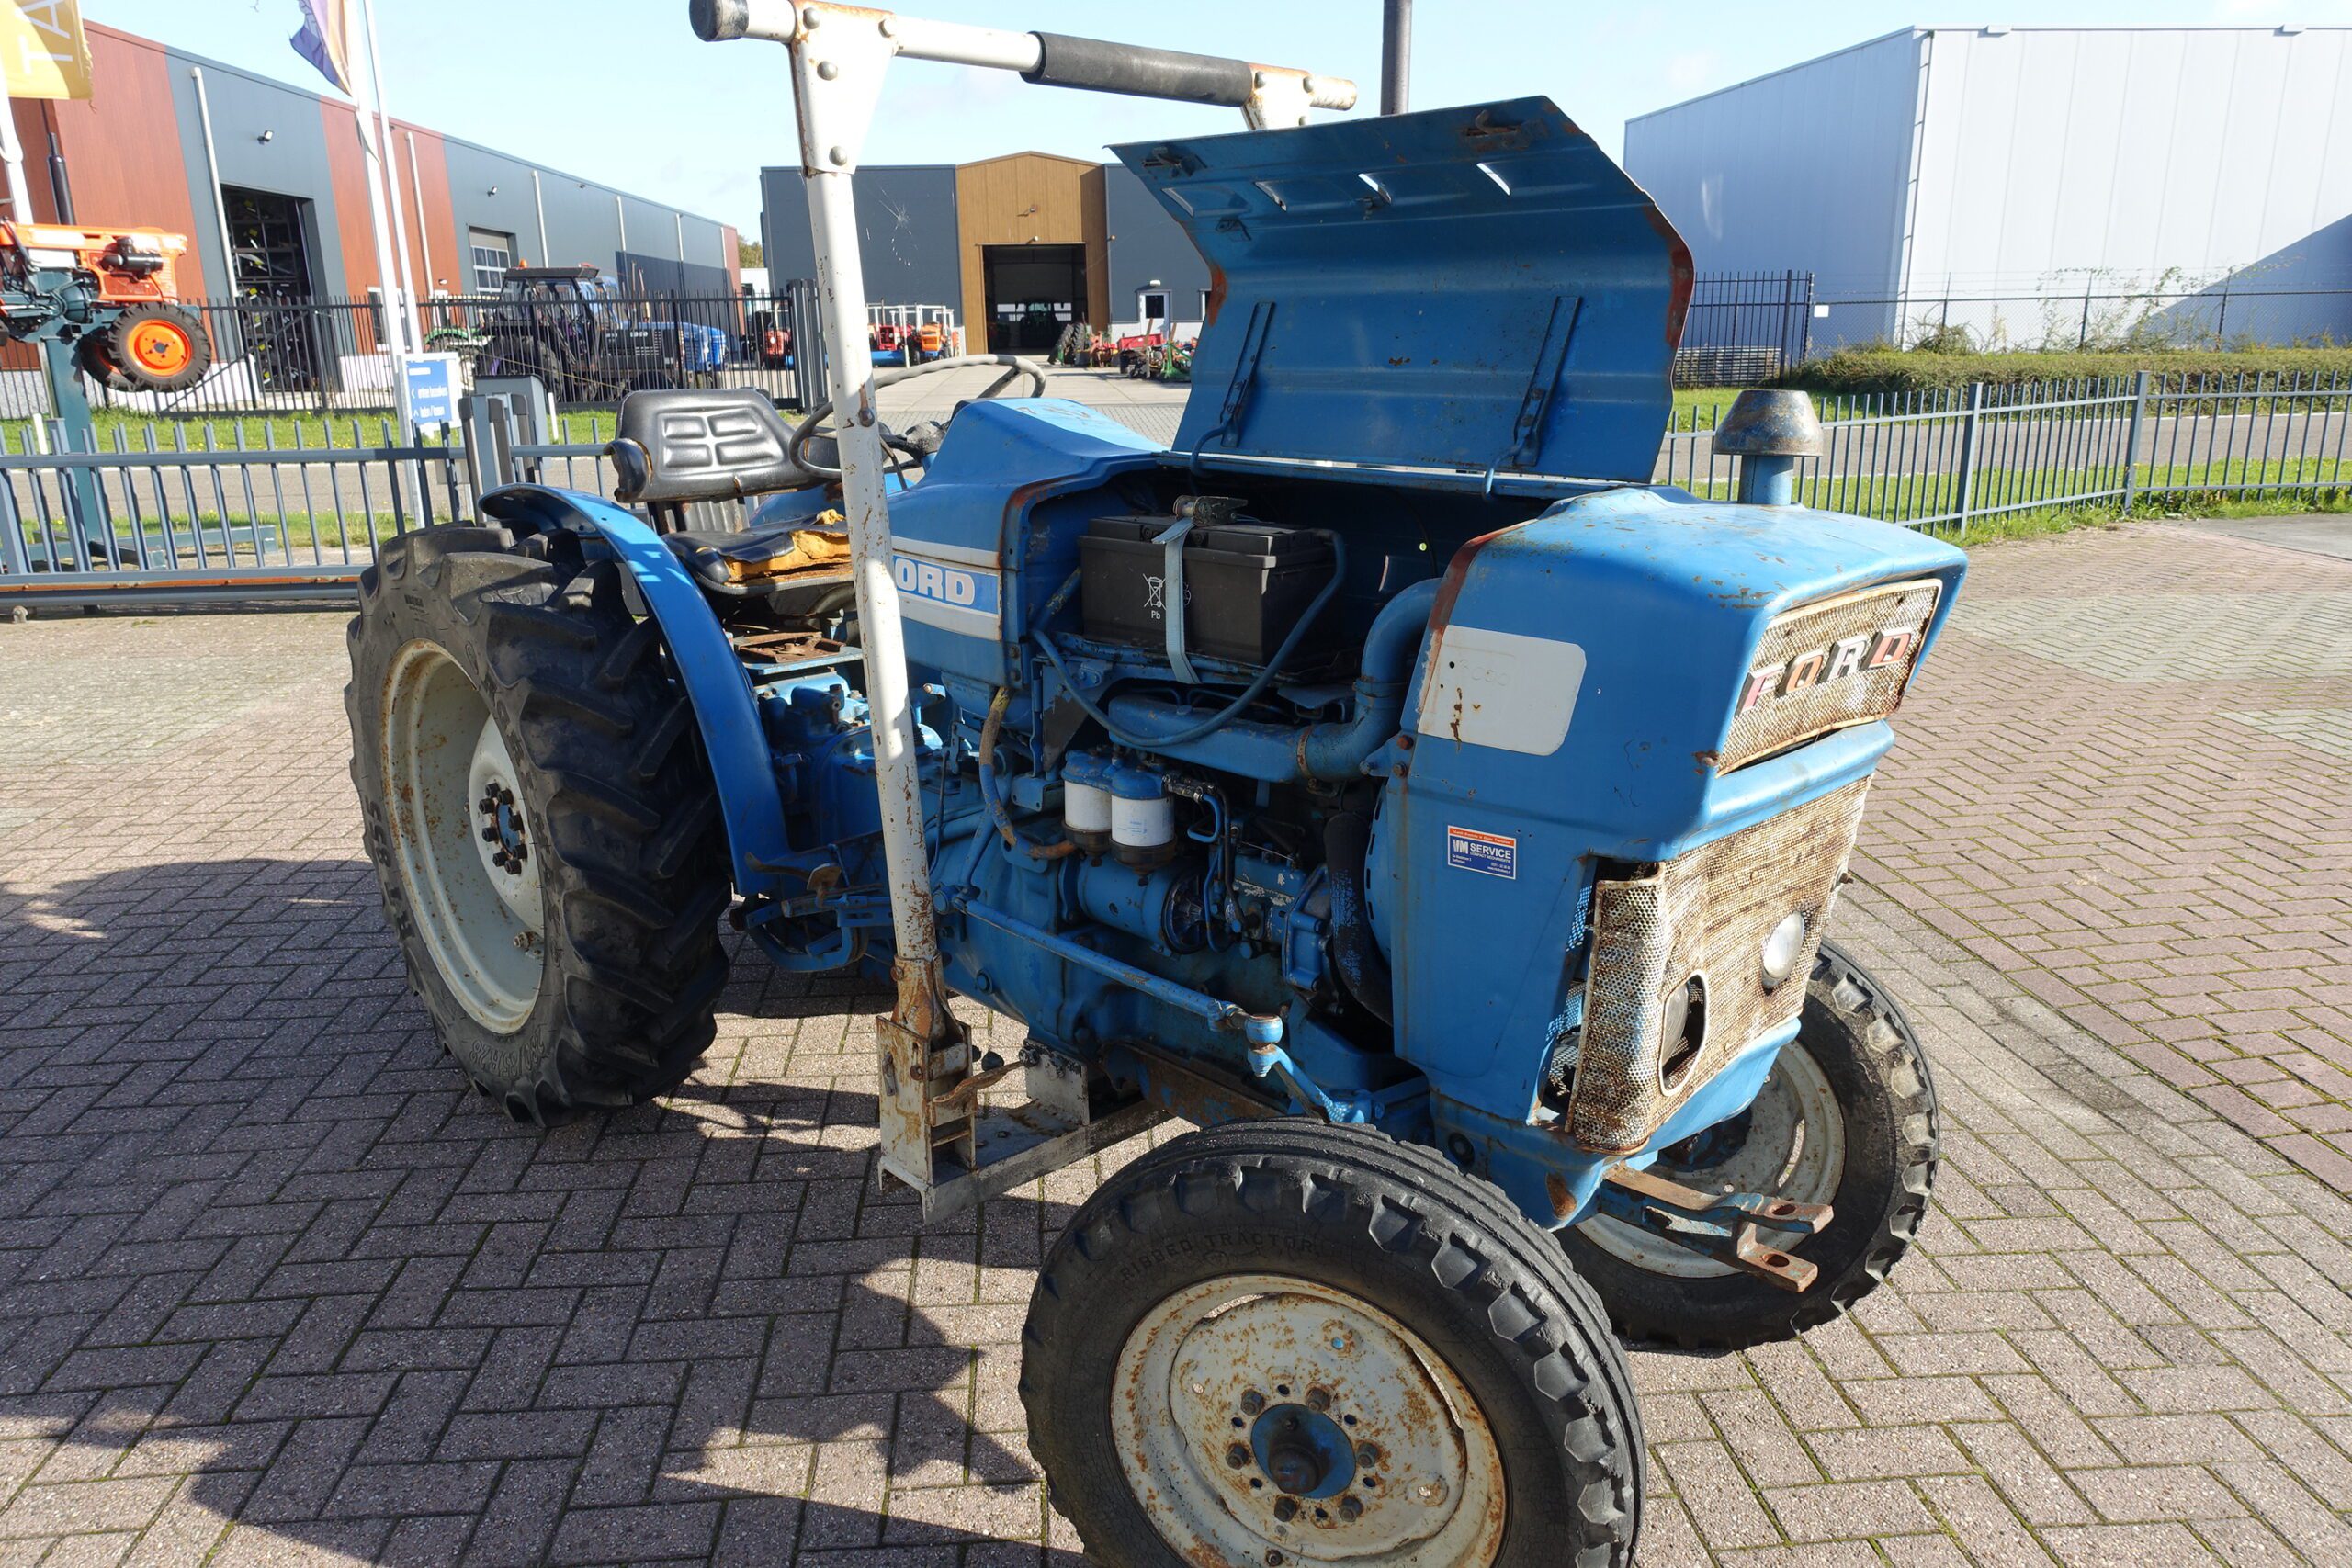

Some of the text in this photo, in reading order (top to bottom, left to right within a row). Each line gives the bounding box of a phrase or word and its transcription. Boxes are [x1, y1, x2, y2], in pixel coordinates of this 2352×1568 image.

[894, 558, 976, 606] ORD
[1150, 609, 1161, 620] Pb
[1734, 626, 1914, 717] FORD
[1469, 842, 1511, 859] SERVICE
[1119, 1232, 1314, 1280] RIBBED TRACTOR
